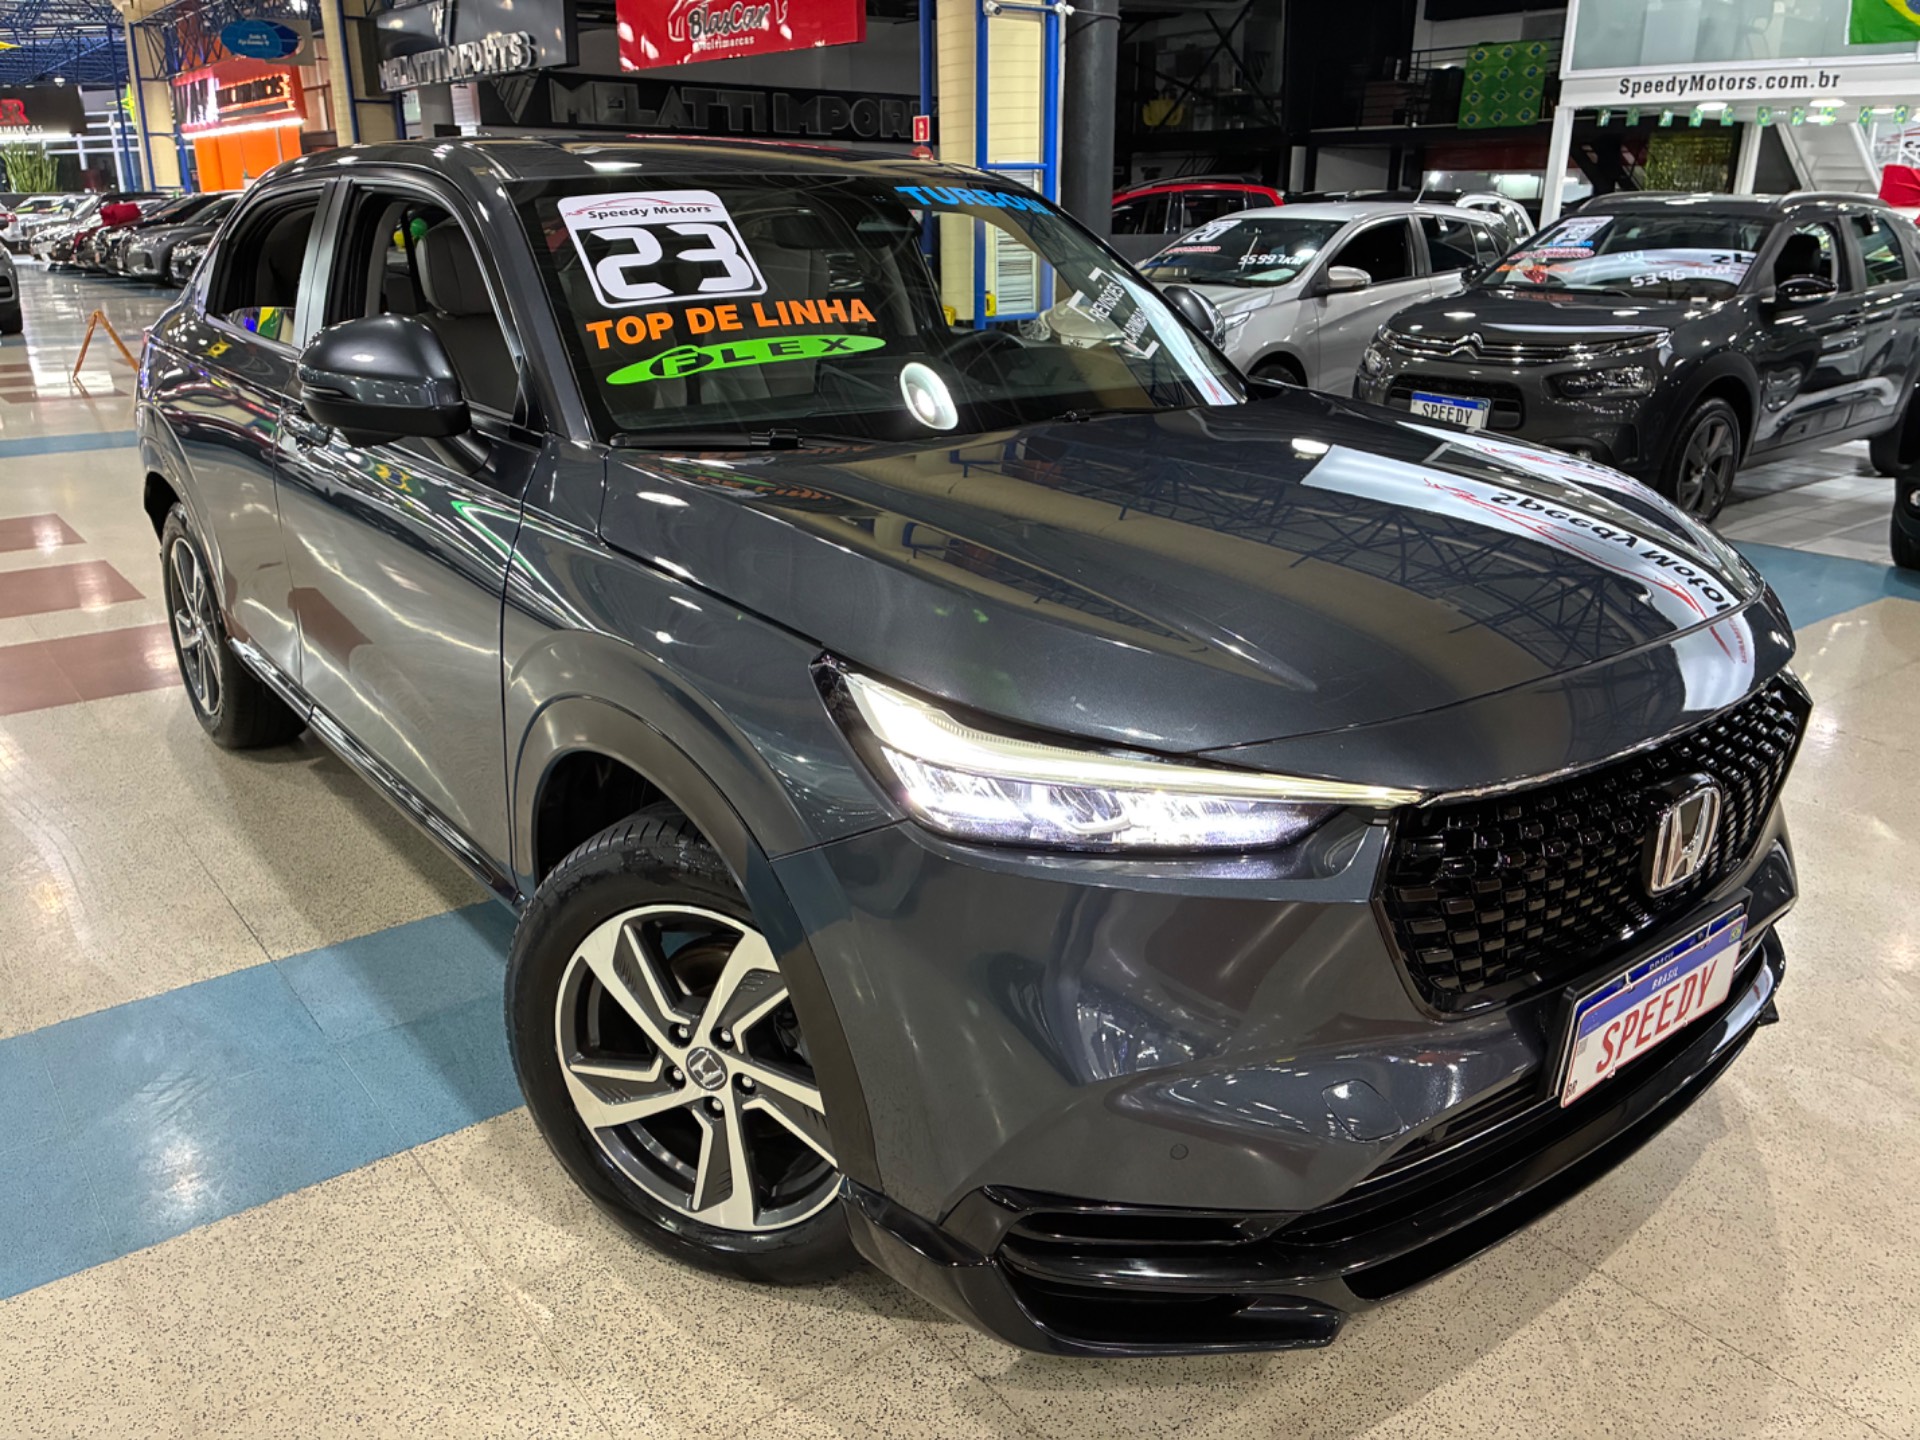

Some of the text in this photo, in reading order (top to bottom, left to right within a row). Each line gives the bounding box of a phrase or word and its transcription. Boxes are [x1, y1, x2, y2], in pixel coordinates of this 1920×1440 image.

[689, 1, 771, 40] BlasCar
[1619, 71, 1841, 97] SpeedyMotors.com.br
[549, 78, 767, 132] MELATTI
[588, 203, 712, 220] Speedy Motors
[590, 222, 755, 299] 23
[586, 298, 877, 350] TOP DE LINHA
[661, 337, 855, 376] FLEX
[1422, 403, 1473, 425] SPEEDY
[1597, 960, 1718, 1074] SPEEDY
